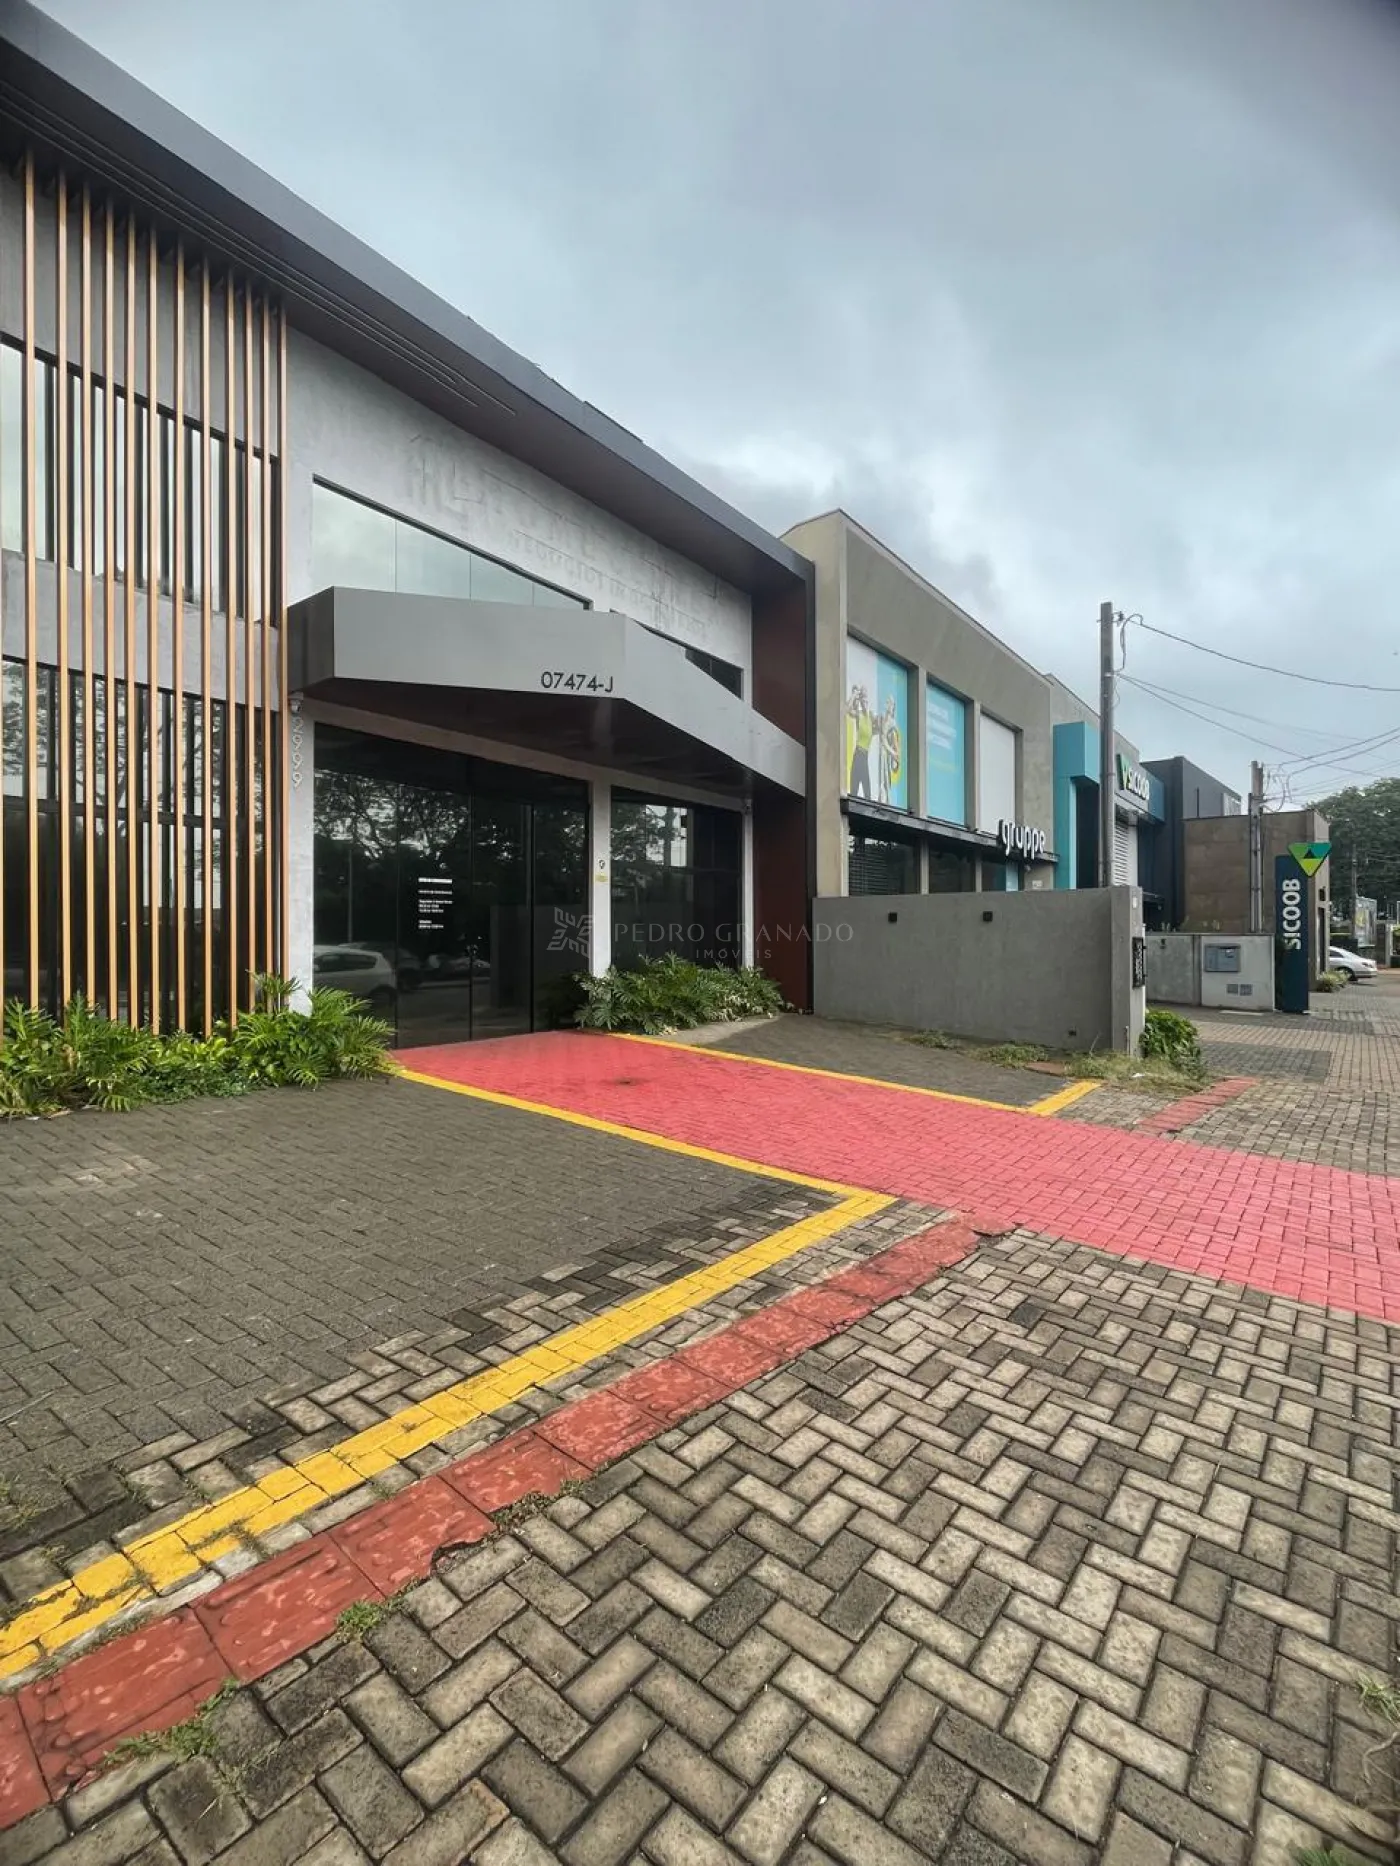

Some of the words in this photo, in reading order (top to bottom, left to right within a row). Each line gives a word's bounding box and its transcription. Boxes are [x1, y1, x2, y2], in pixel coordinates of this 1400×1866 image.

[541, 671, 613, 692] 07474-J
[292, 716, 303, 788] 2999
[1002, 820, 1046, 860] gruppe
[1282, 879, 1301, 949] SICOOB
